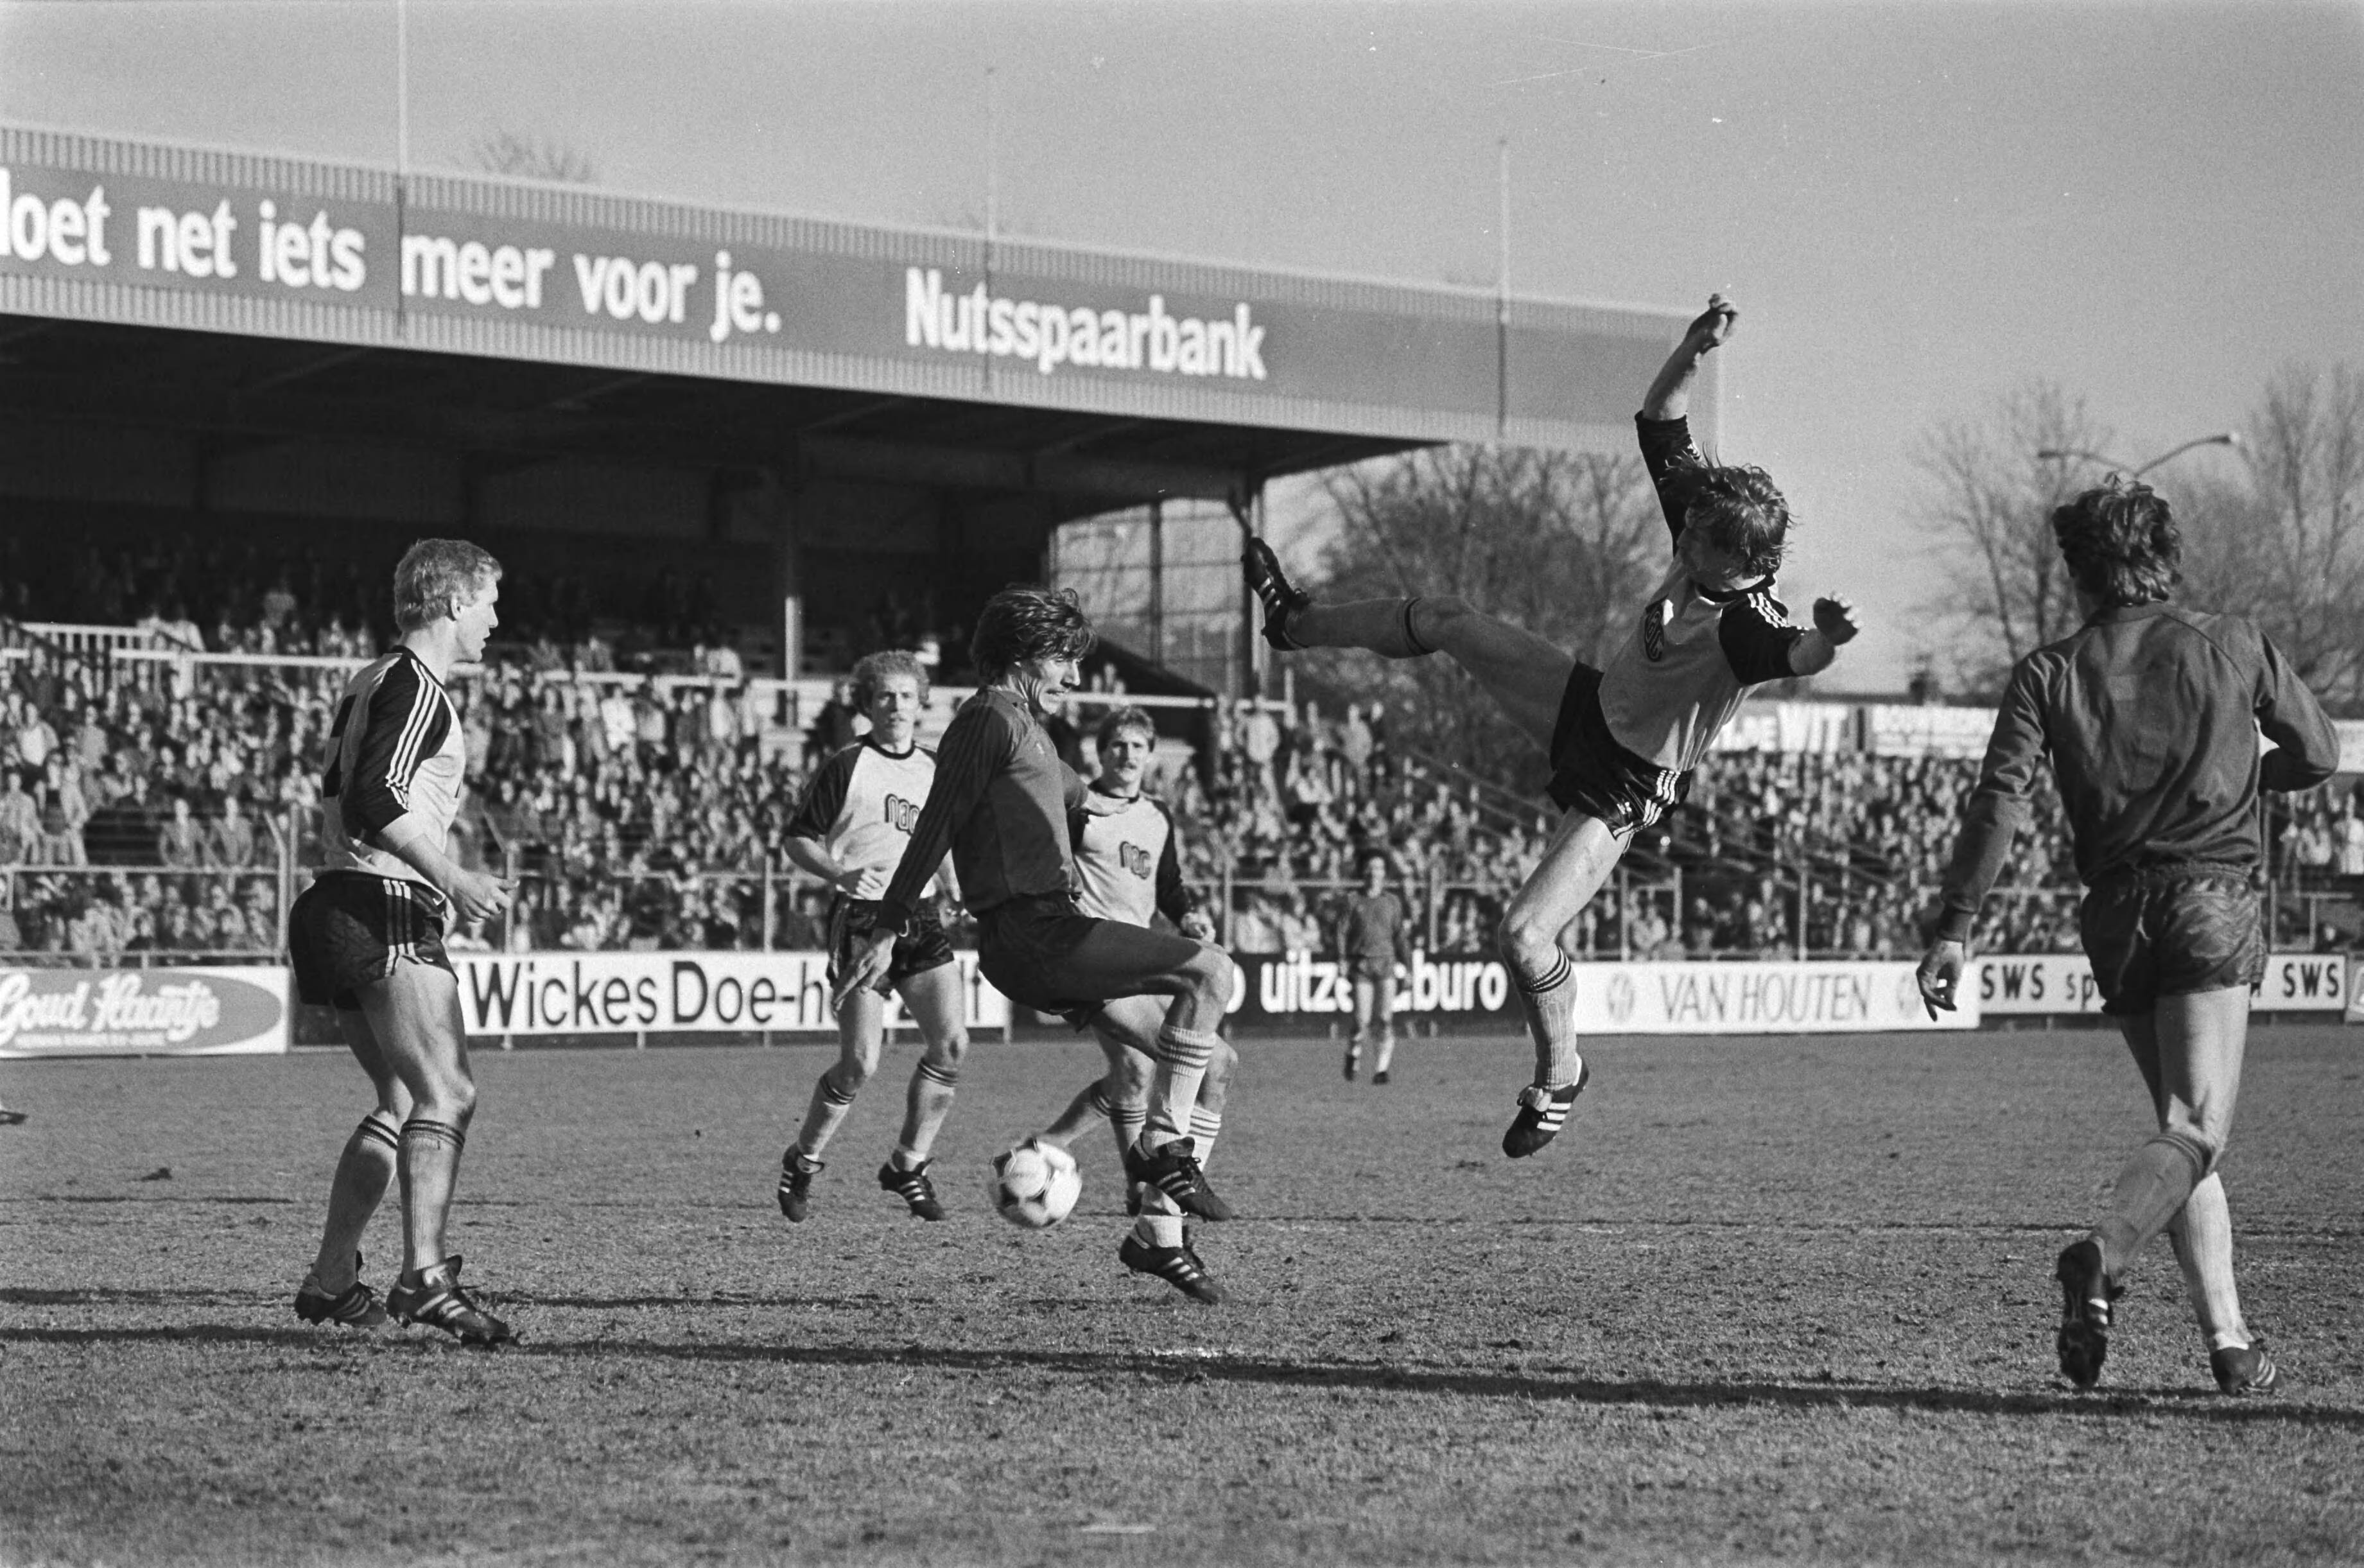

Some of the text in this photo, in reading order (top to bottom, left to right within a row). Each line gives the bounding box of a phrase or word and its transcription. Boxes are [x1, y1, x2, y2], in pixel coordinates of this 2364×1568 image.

[136, 198, 238, 279] net
[258, 198, 366, 292] iets
[401, 235, 556, 309] meer
[573, 254, 699, 325] voor
[709, 248, 782, 343] je.
[905, 266, 1267, 380] Nutsspaarbank
[469, 961, 657, 1027] Wickes
[1660, 972, 1872, 1024] VAN HOUTEN
[1980, 963, 2045, 1000] SWS
[2282, 963, 2339, 998] SWS
